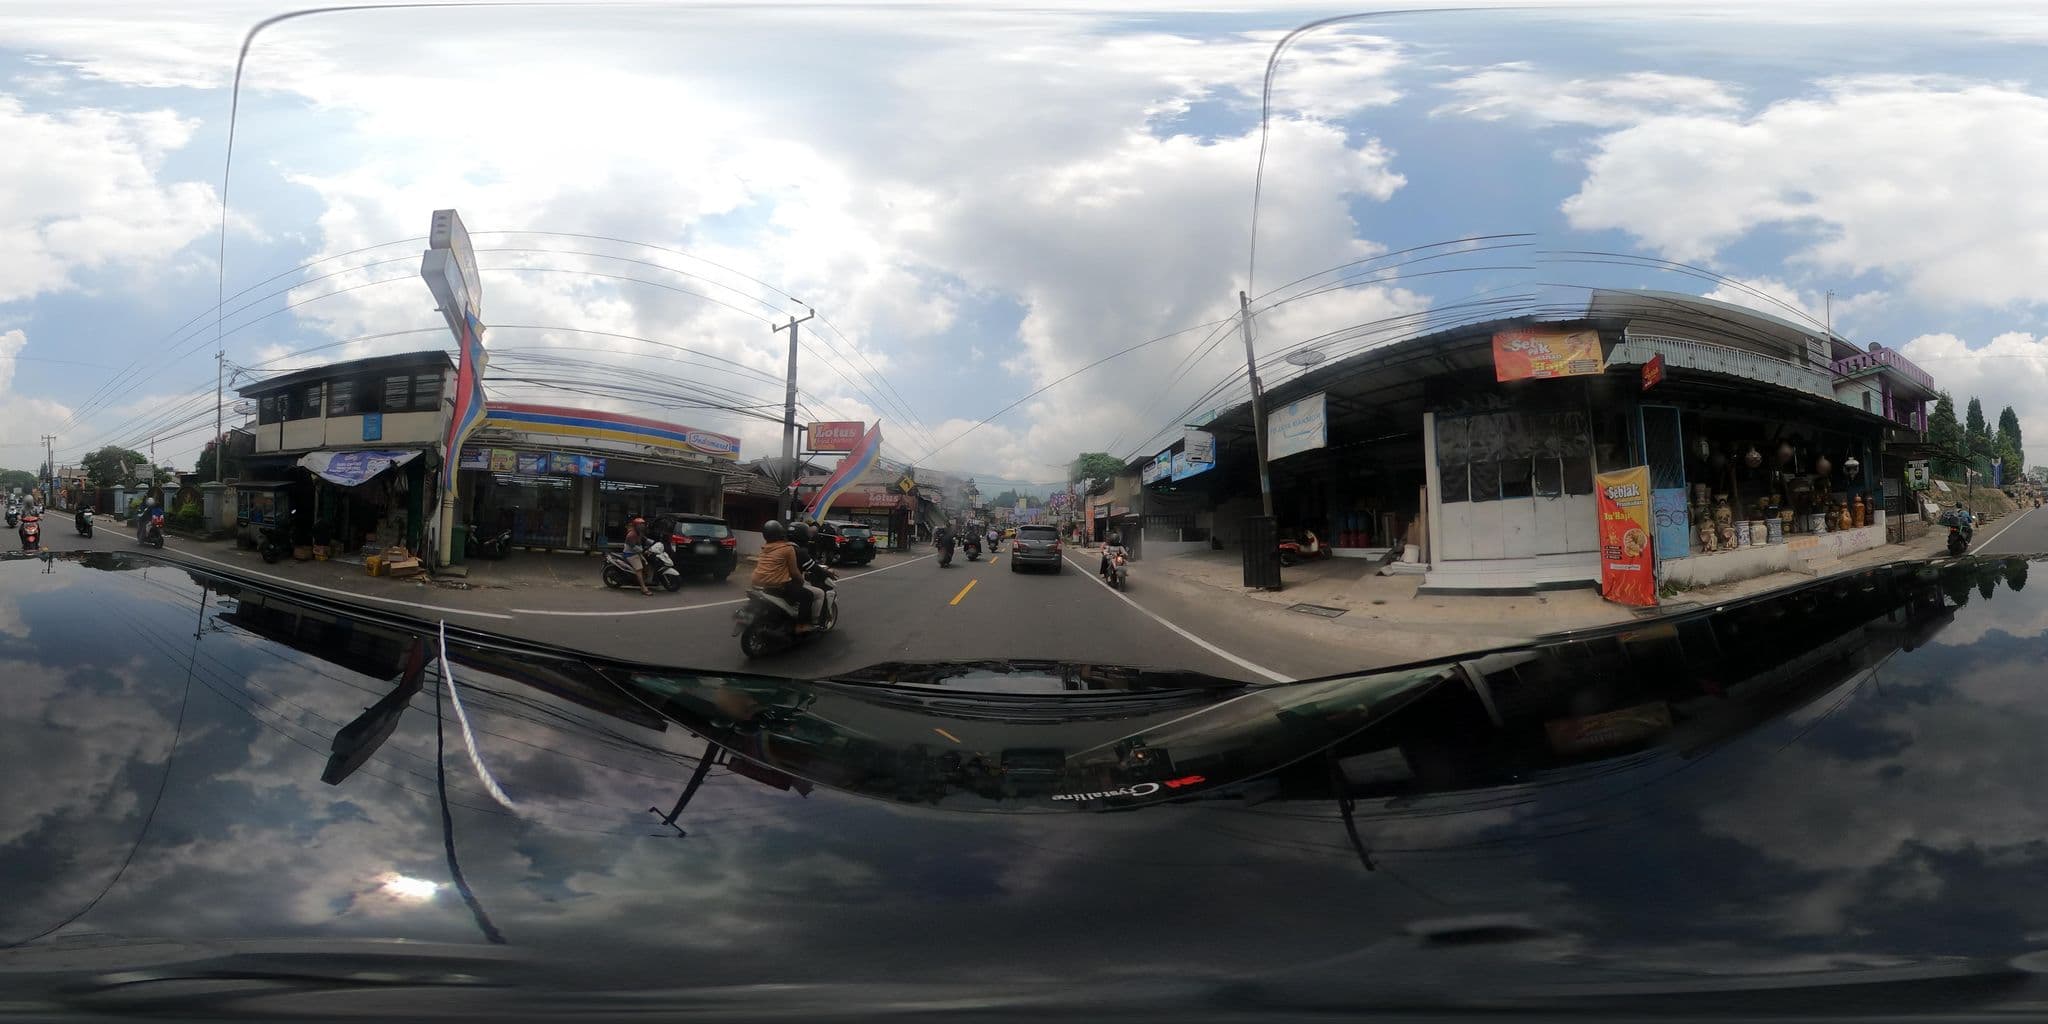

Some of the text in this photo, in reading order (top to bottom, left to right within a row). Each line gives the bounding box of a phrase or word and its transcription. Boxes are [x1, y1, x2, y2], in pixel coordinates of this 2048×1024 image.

[816, 424, 856, 438] Lotus
[1608, 484, 1640, 499] Seblak
[1052, 782, 1160, 801] Crystalline
